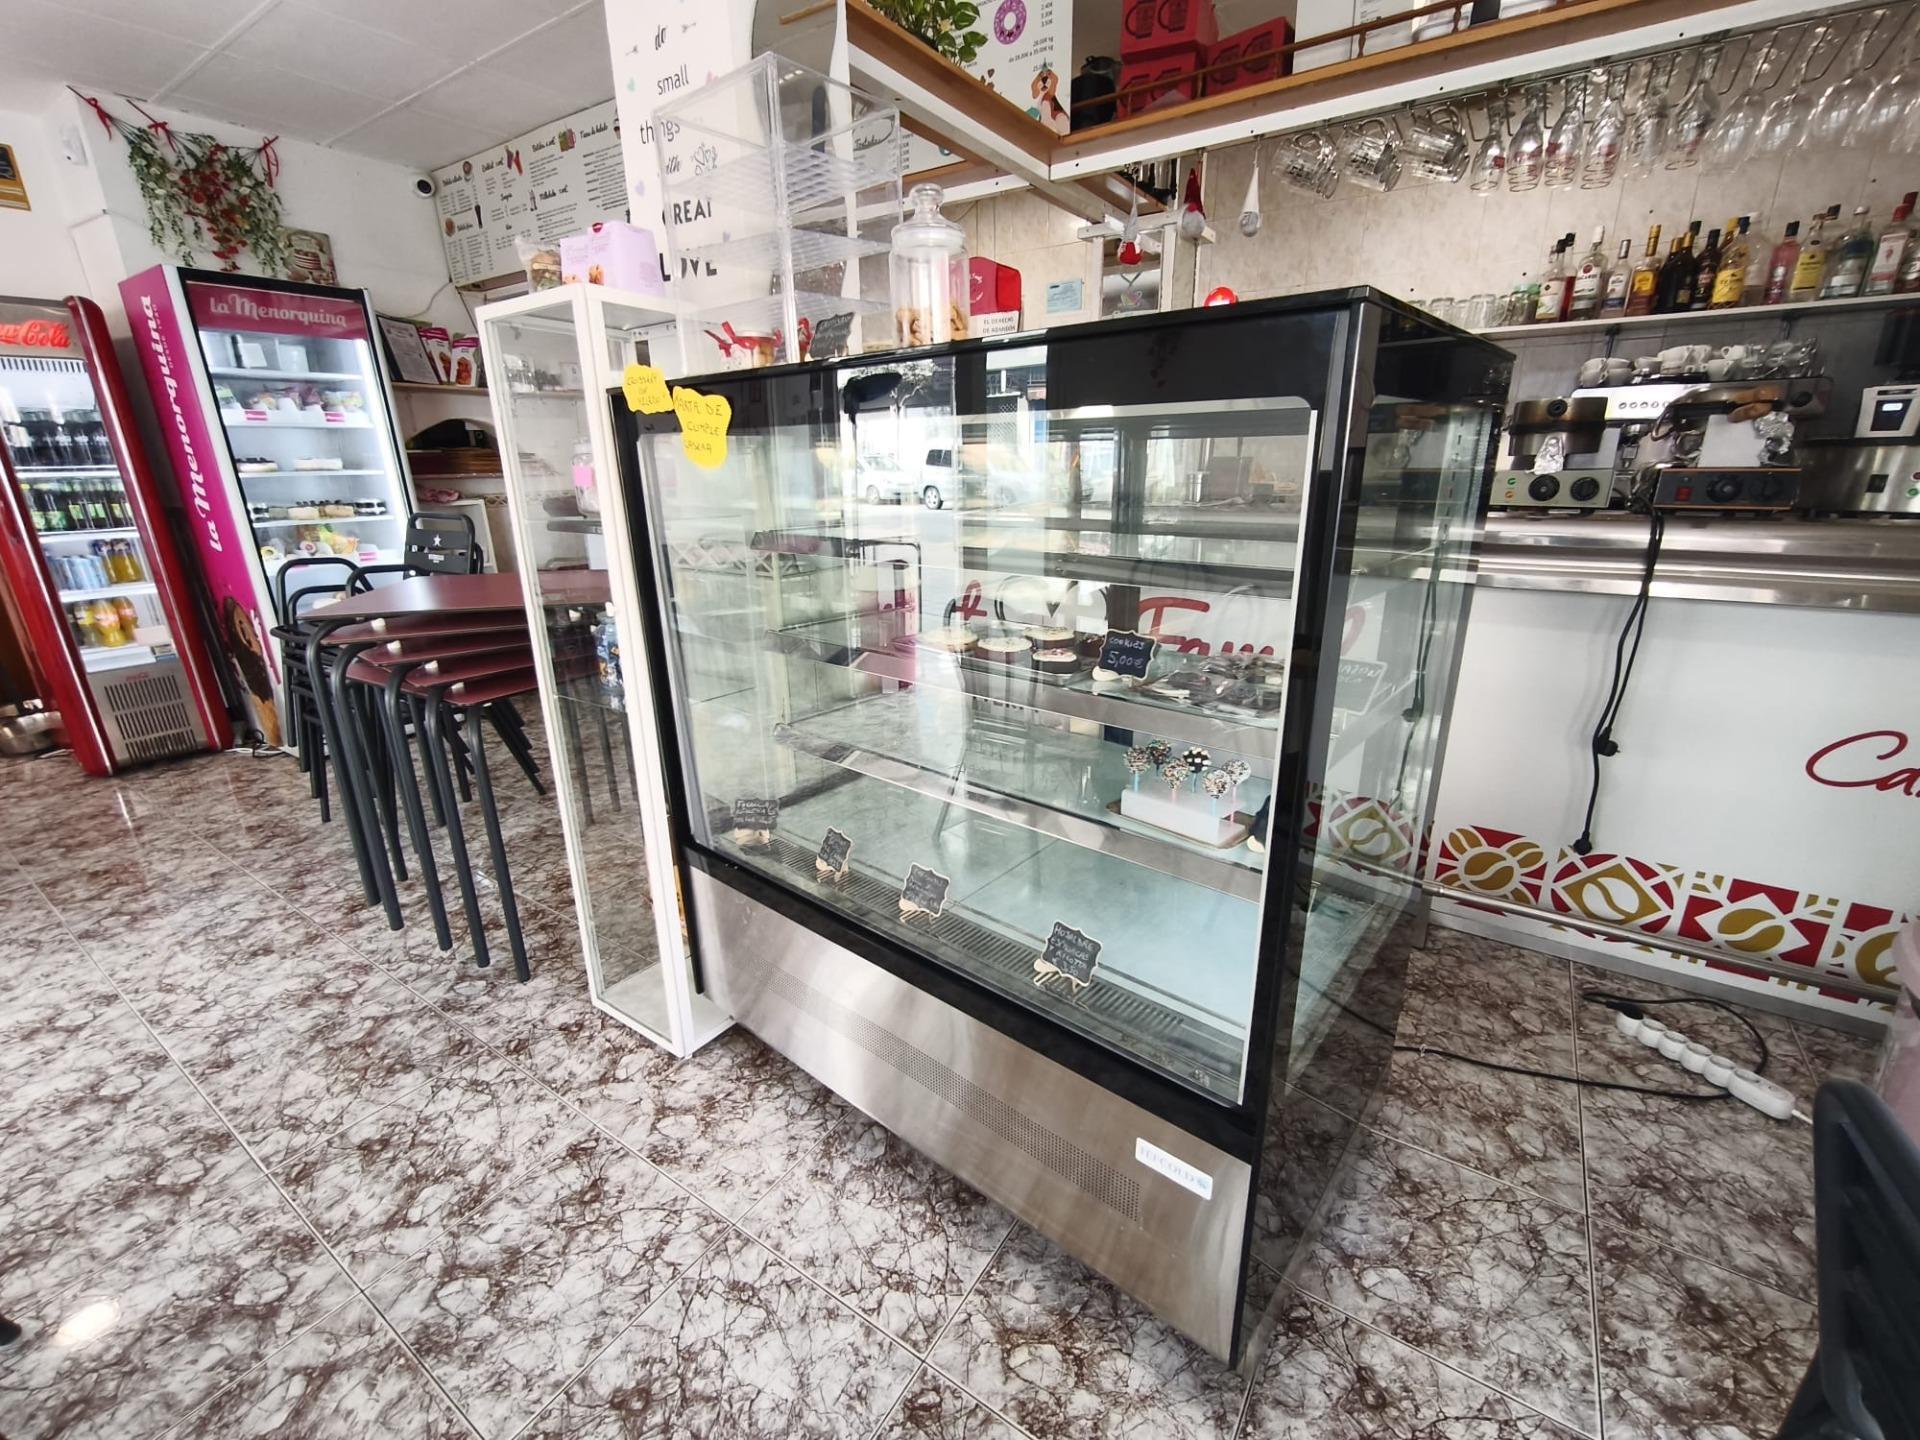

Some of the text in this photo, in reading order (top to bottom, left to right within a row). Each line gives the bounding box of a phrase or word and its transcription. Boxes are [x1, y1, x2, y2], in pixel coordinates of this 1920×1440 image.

[656, 63, 690, 96] small
[640, 120, 681, 145] thngs
[227, 293, 348, 328] Menorquina
[140, 294, 208, 519] Menorquina
[1107, 650, 1144, 668] 5,00€
[1806, 730, 1920, 798] Ca
